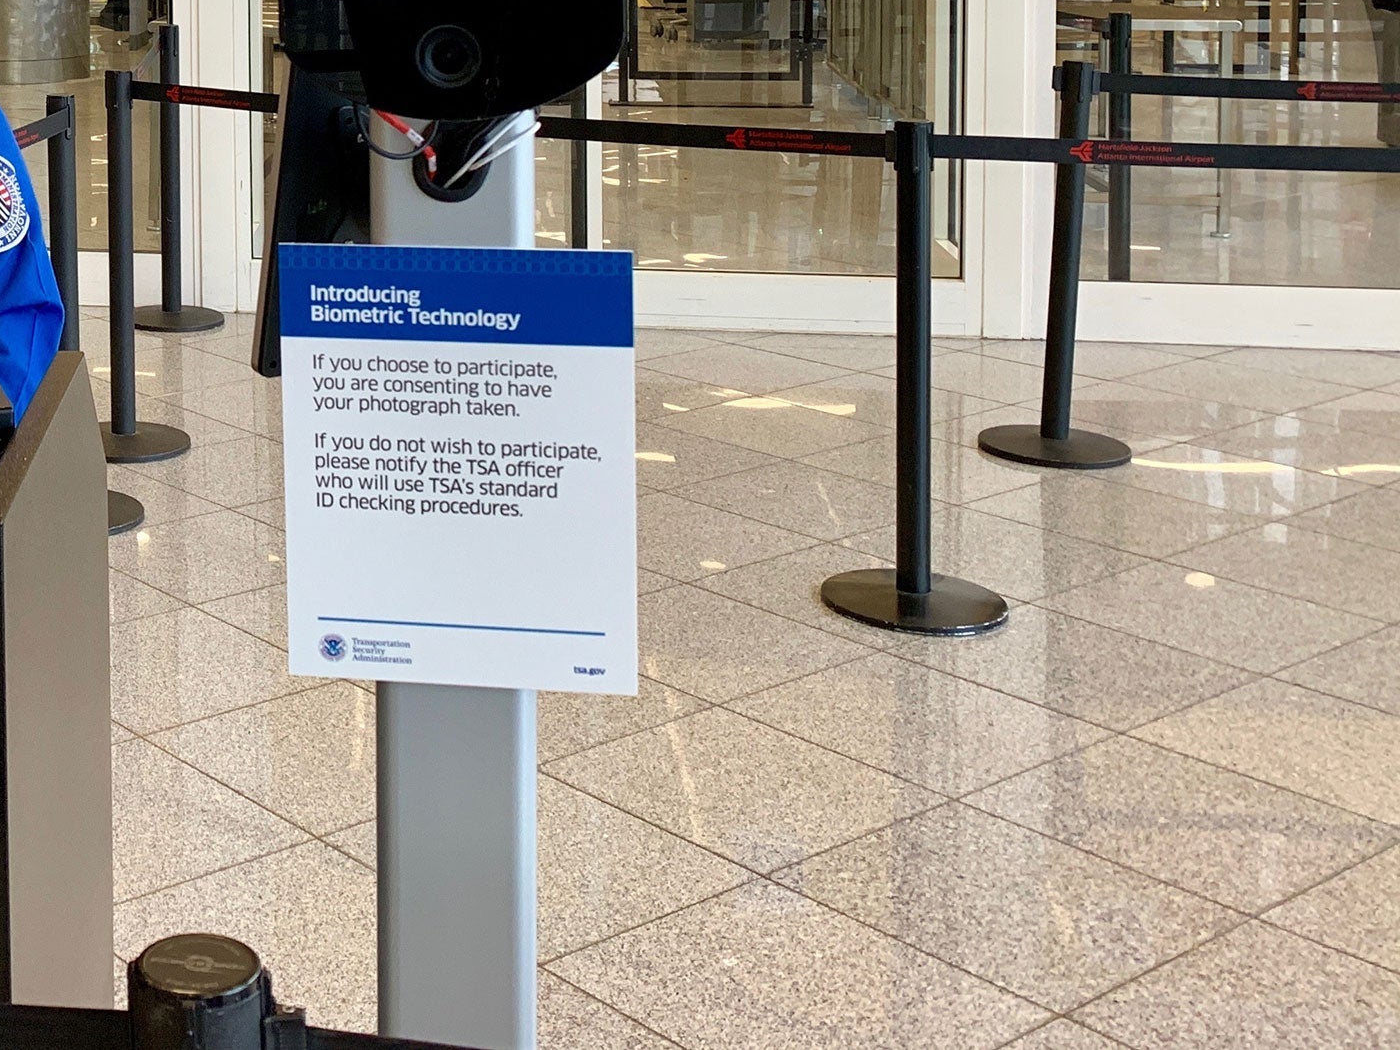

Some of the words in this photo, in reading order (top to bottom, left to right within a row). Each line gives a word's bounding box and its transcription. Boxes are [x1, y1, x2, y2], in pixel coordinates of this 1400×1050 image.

[1098, 153, 1128, 161] Atlanta
[1129, 154, 1183, 163] International
[1185, 155, 1215, 164] Airport
[310, 285, 420, 307] Introducing
[310, 305, 404, 324] Biometric
[407, 308, 520, 331] Technology
[312, 354, 325, 369] If
[329, 357, 362, 373] you
[367, 356, 429, 374] choose
[433, 358, 451, 374] to
[457, 360, 558, 379] participate,
[312, 376, 345, 392] you
[350, 378, 379, 392] are
[383, 378, 479, 398] consenting
[483, 381, 503, 396] to
[507, 381, 552, 399] have
[313, 396, 354, 412] your
[359, 396, 461, 417] photograph
[466, 399, 520, 417] taken.
[315, 433, 326, 449] If
[331, 436, 364, 452] you
[369, 435, 392, 452] do
[397, 437, 426, 453] not
[431, 437, 473, 455] wish
[478, 440, 496, 456] to
[501, 441, 602, 462] participate,
[315, 453, 370, 471] please
[375, 456, 428, 475] notify
[433, 457, 462, 474] the
[466, 459, 501, 476] TSA
[505, 461, 564, 478] officer
[315, 473, 353, 489] who
[359, 474, 388, 491] will
[393, 478, 424, 493] use
[429, 477, 474, 495] TSA's
[479, 481, 558, 499] standard
[316, 492, 334, 508] ID
[339, 493, 416, 514] checking
[420, 497, 524, 517] procedures.
[352, 637, 411, 649] Transportation
[352, 646, 386, 656] Security
[352, 654, 413, 665] Administration
[573, 665, 606, 677] tsa.gov
